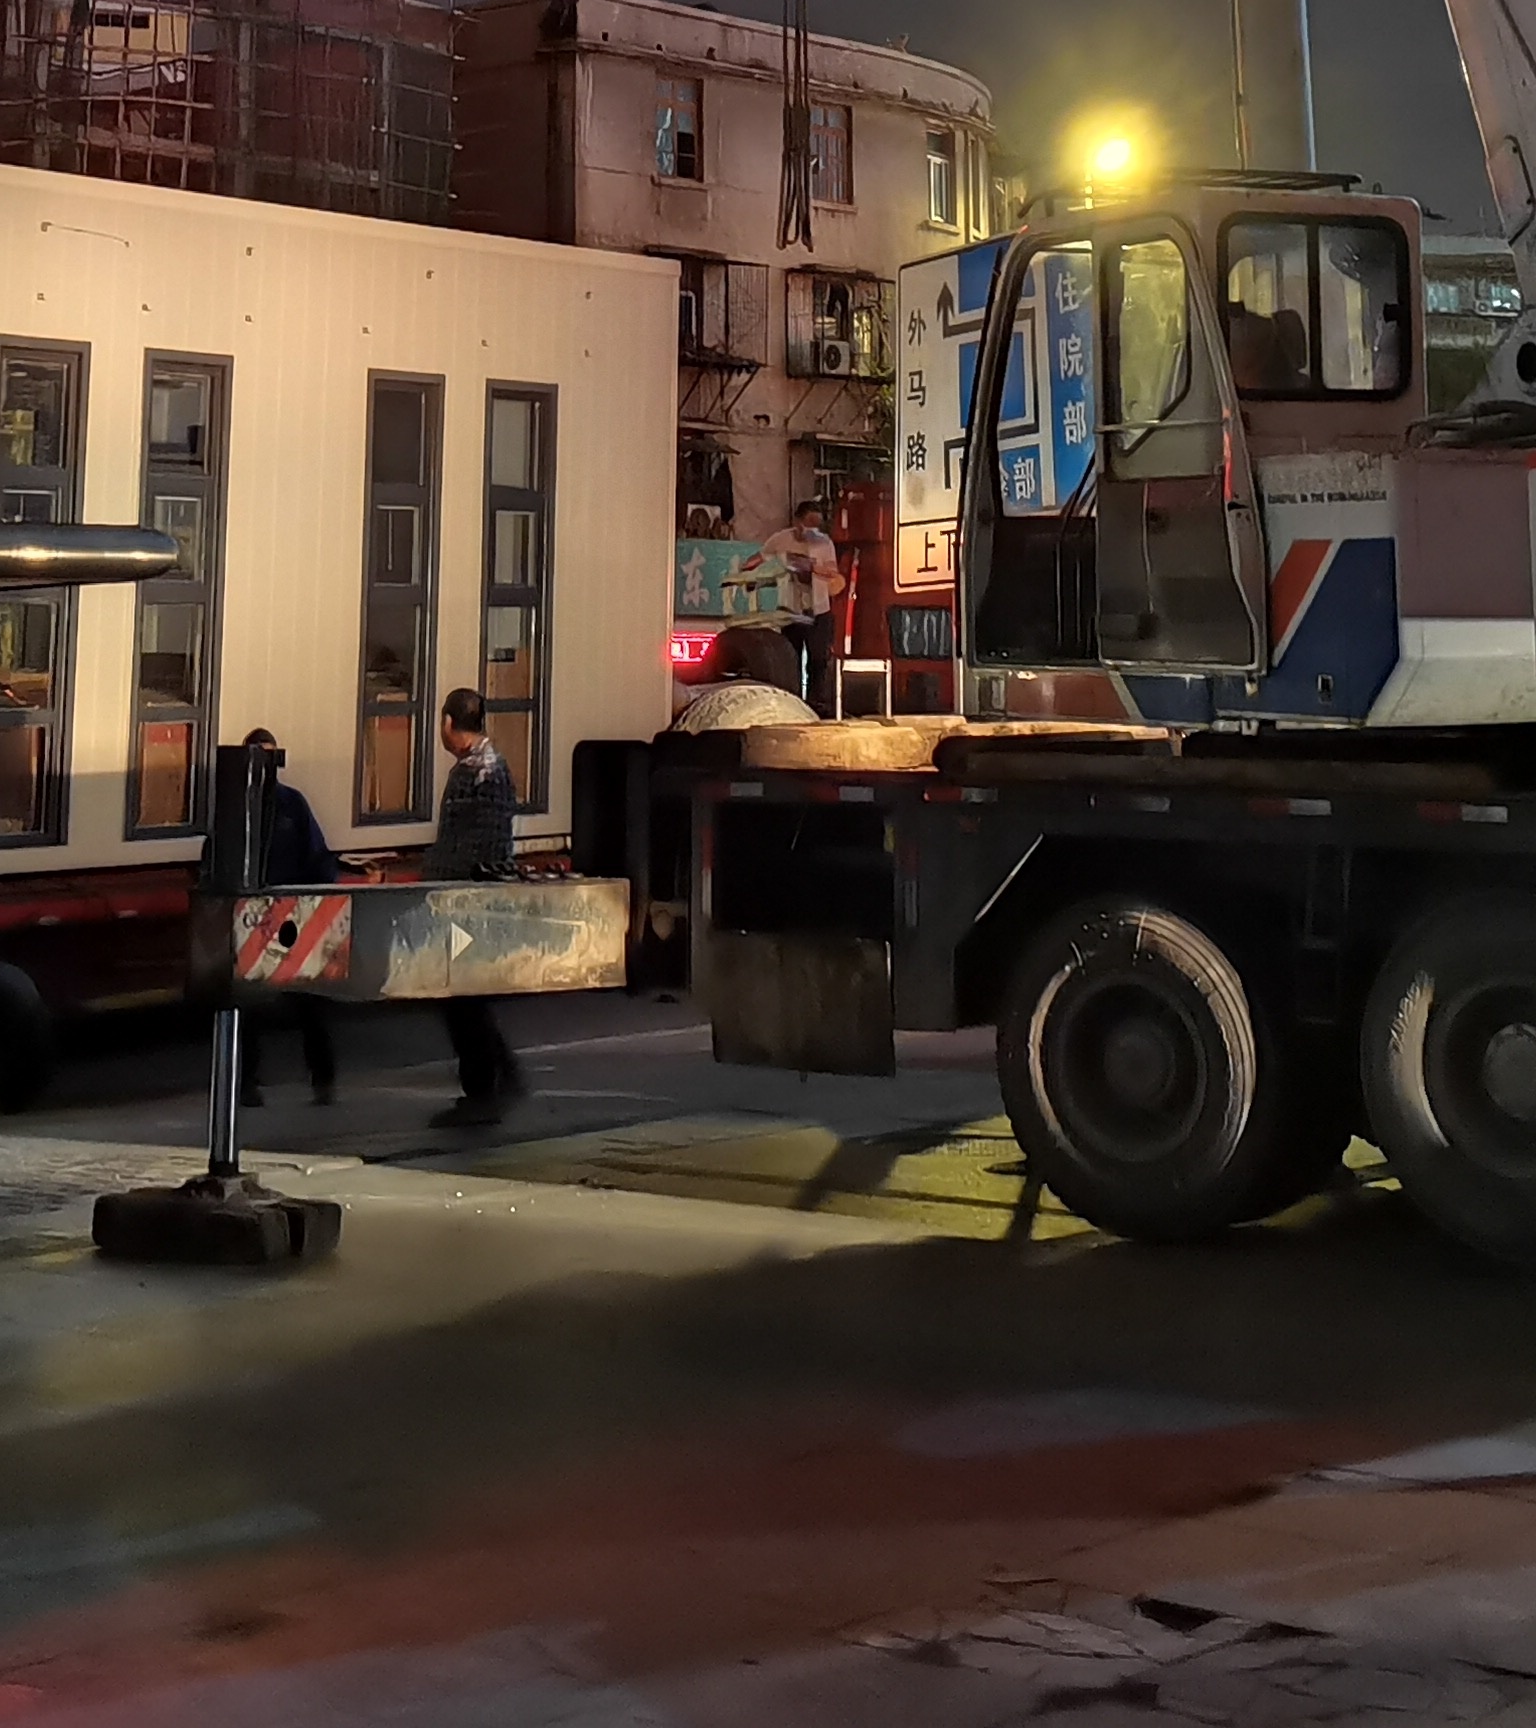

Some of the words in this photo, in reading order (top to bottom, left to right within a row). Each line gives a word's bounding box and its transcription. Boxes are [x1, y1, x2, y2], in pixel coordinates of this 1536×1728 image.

[906, 308, 928, 472] 外马路
[1055, 271, 1088, 446] 住院部
